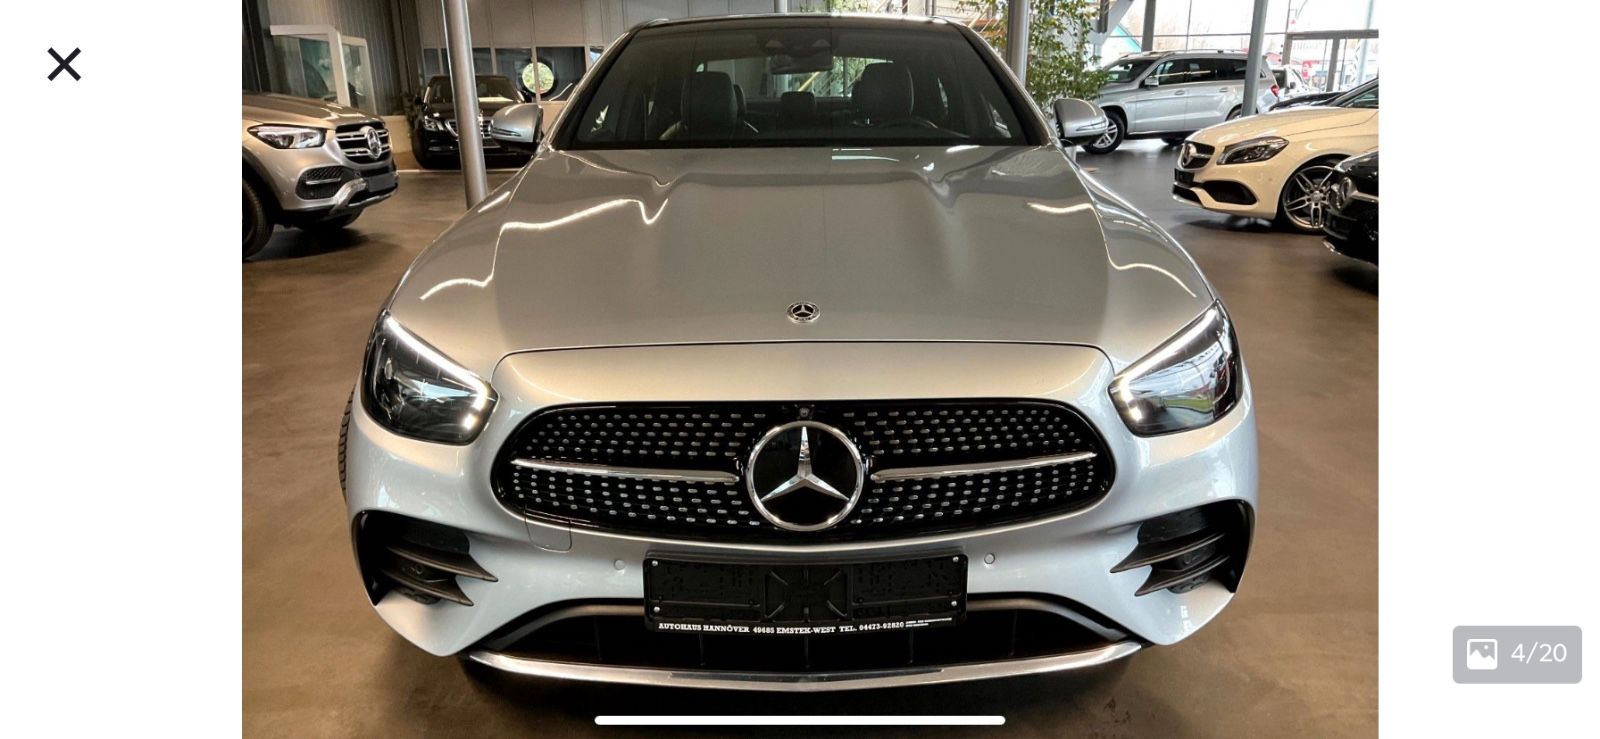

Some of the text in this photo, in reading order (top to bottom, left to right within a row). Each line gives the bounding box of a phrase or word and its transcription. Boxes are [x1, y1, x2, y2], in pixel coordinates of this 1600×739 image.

[658, 622, 702, 631] AUTOHAUS
[775, 626, 837, 635] EMSTEK-WEST
[838, 625, 858, 633] TEL.
